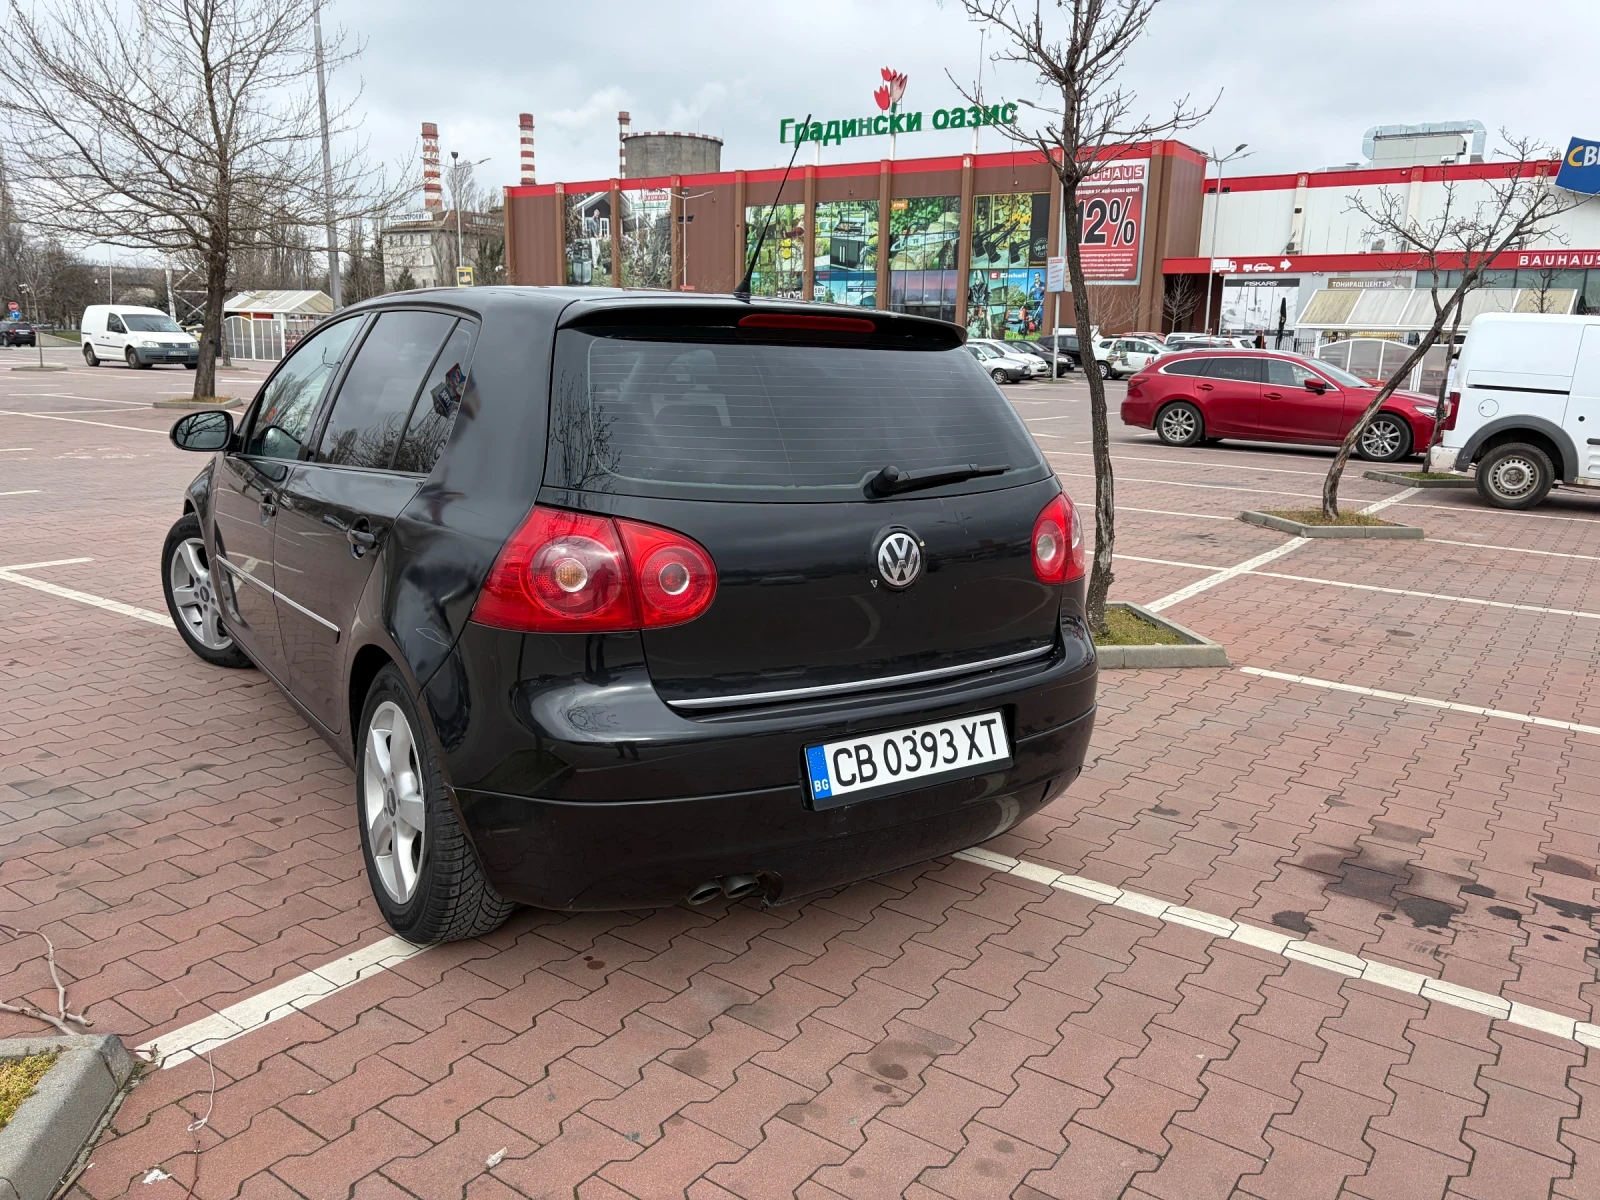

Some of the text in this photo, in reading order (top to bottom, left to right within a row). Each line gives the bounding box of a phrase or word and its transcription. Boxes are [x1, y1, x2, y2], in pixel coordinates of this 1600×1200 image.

[780, 102, 1018, 149] Градински оазис
[1083, 165, 1143, 181] UHAUS
[1075, 196, 1137, 247] 12%
[1000, 271, 1027, 279] Einhell
[1332, 280, 1392, 288] ТОНИРАЩ ЦЕНТЪР
[833, 718, 998, 787] CB 0393 XT
[814, 778, 829, 792] BG
